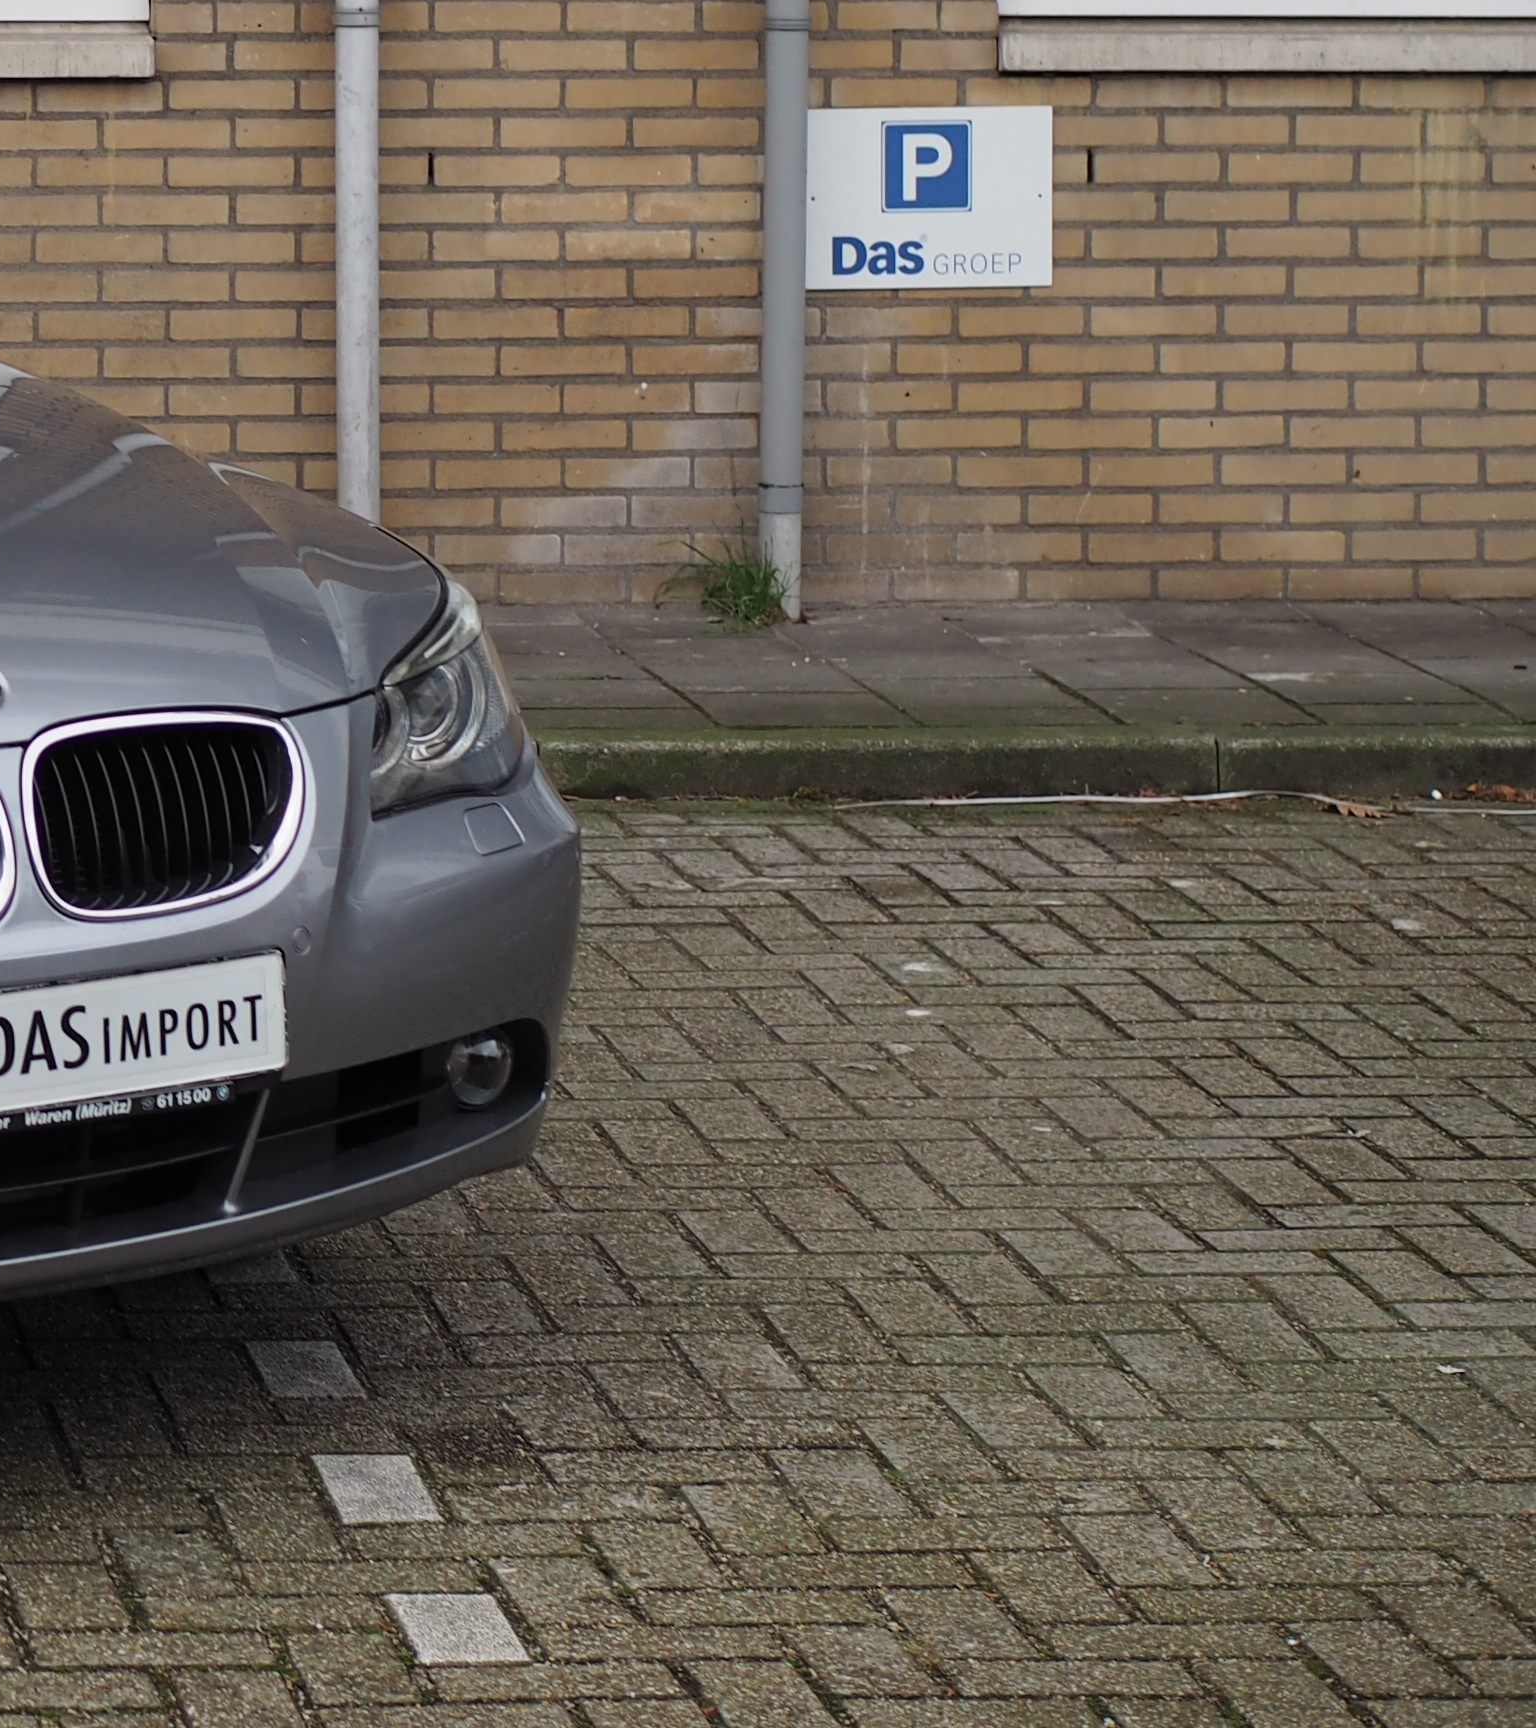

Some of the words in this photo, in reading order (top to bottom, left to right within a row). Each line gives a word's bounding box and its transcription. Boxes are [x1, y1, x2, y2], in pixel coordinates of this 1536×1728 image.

[902, 132, 953, 202] P
[832, 236, 925, 276] Das
[933, 252, 1023, 276] GROEP
[102, 993, 263, 1064] IMPORT
[24, 1107, 72, 1126] Waren
[75, 1098, 132, 1121] (Müritz)
